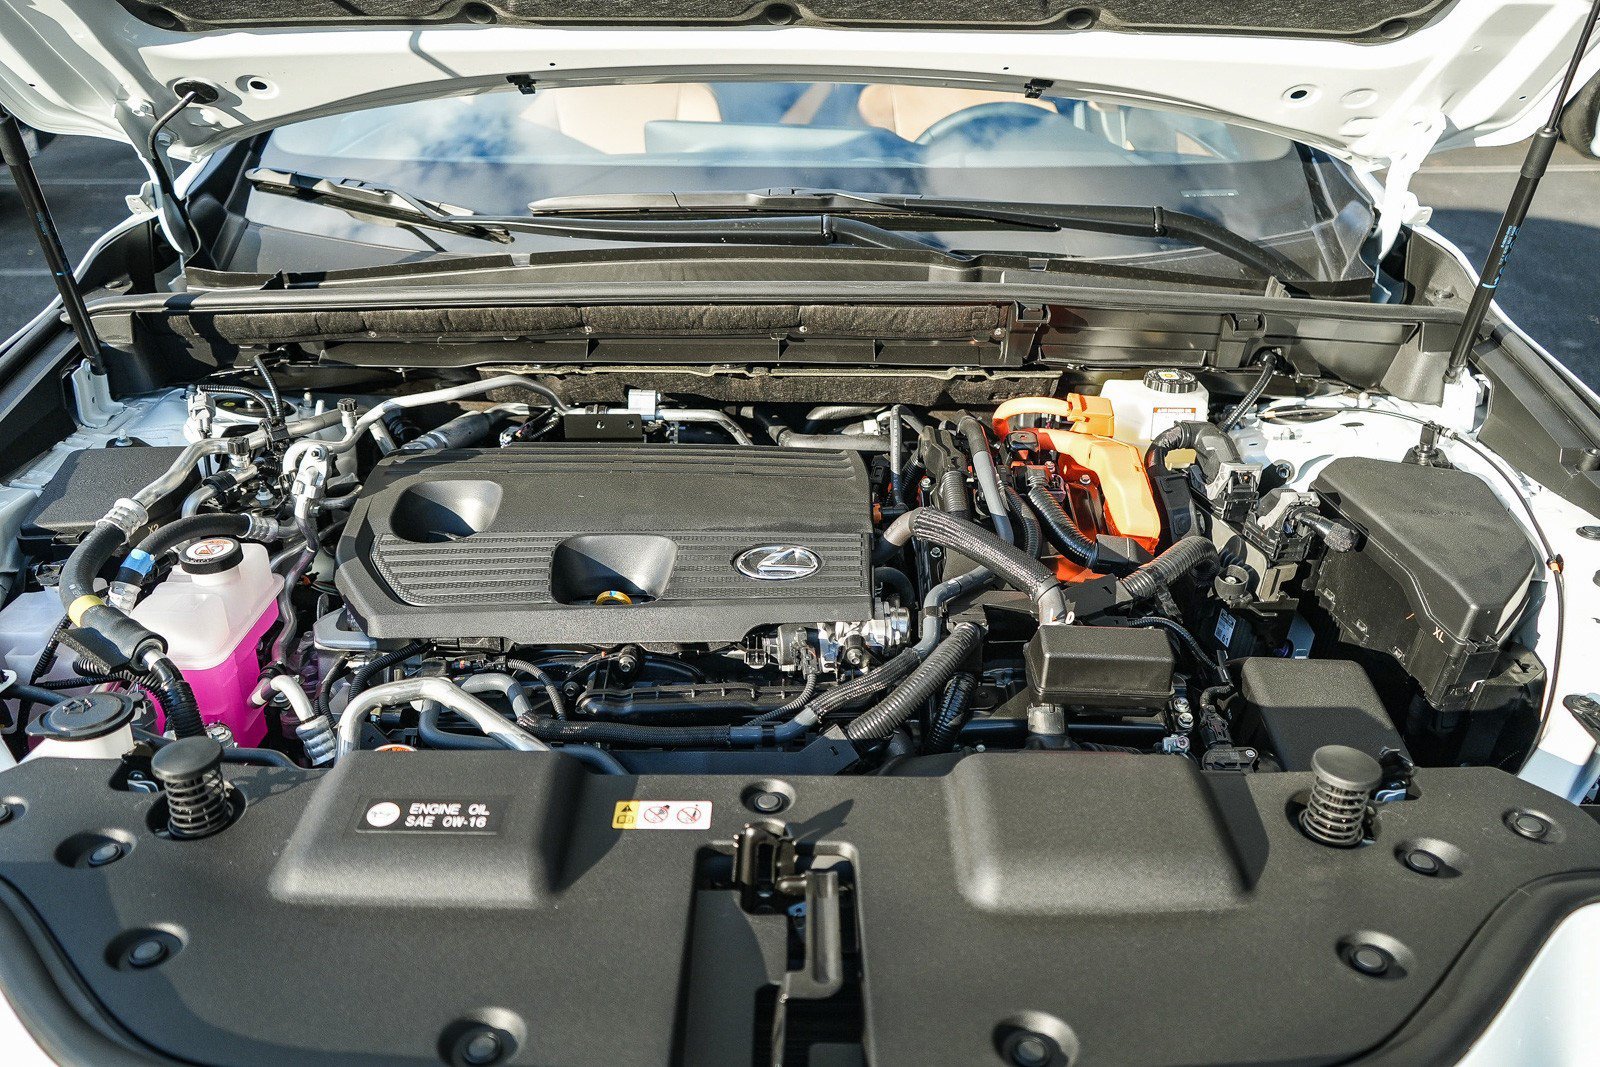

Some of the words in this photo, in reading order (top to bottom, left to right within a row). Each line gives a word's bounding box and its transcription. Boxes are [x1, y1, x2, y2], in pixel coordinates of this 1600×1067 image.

[409, 802, 462, 816] ENGINE
[468, 803, 491, 816] OIL
[404, 815, 436, 828] SAE
